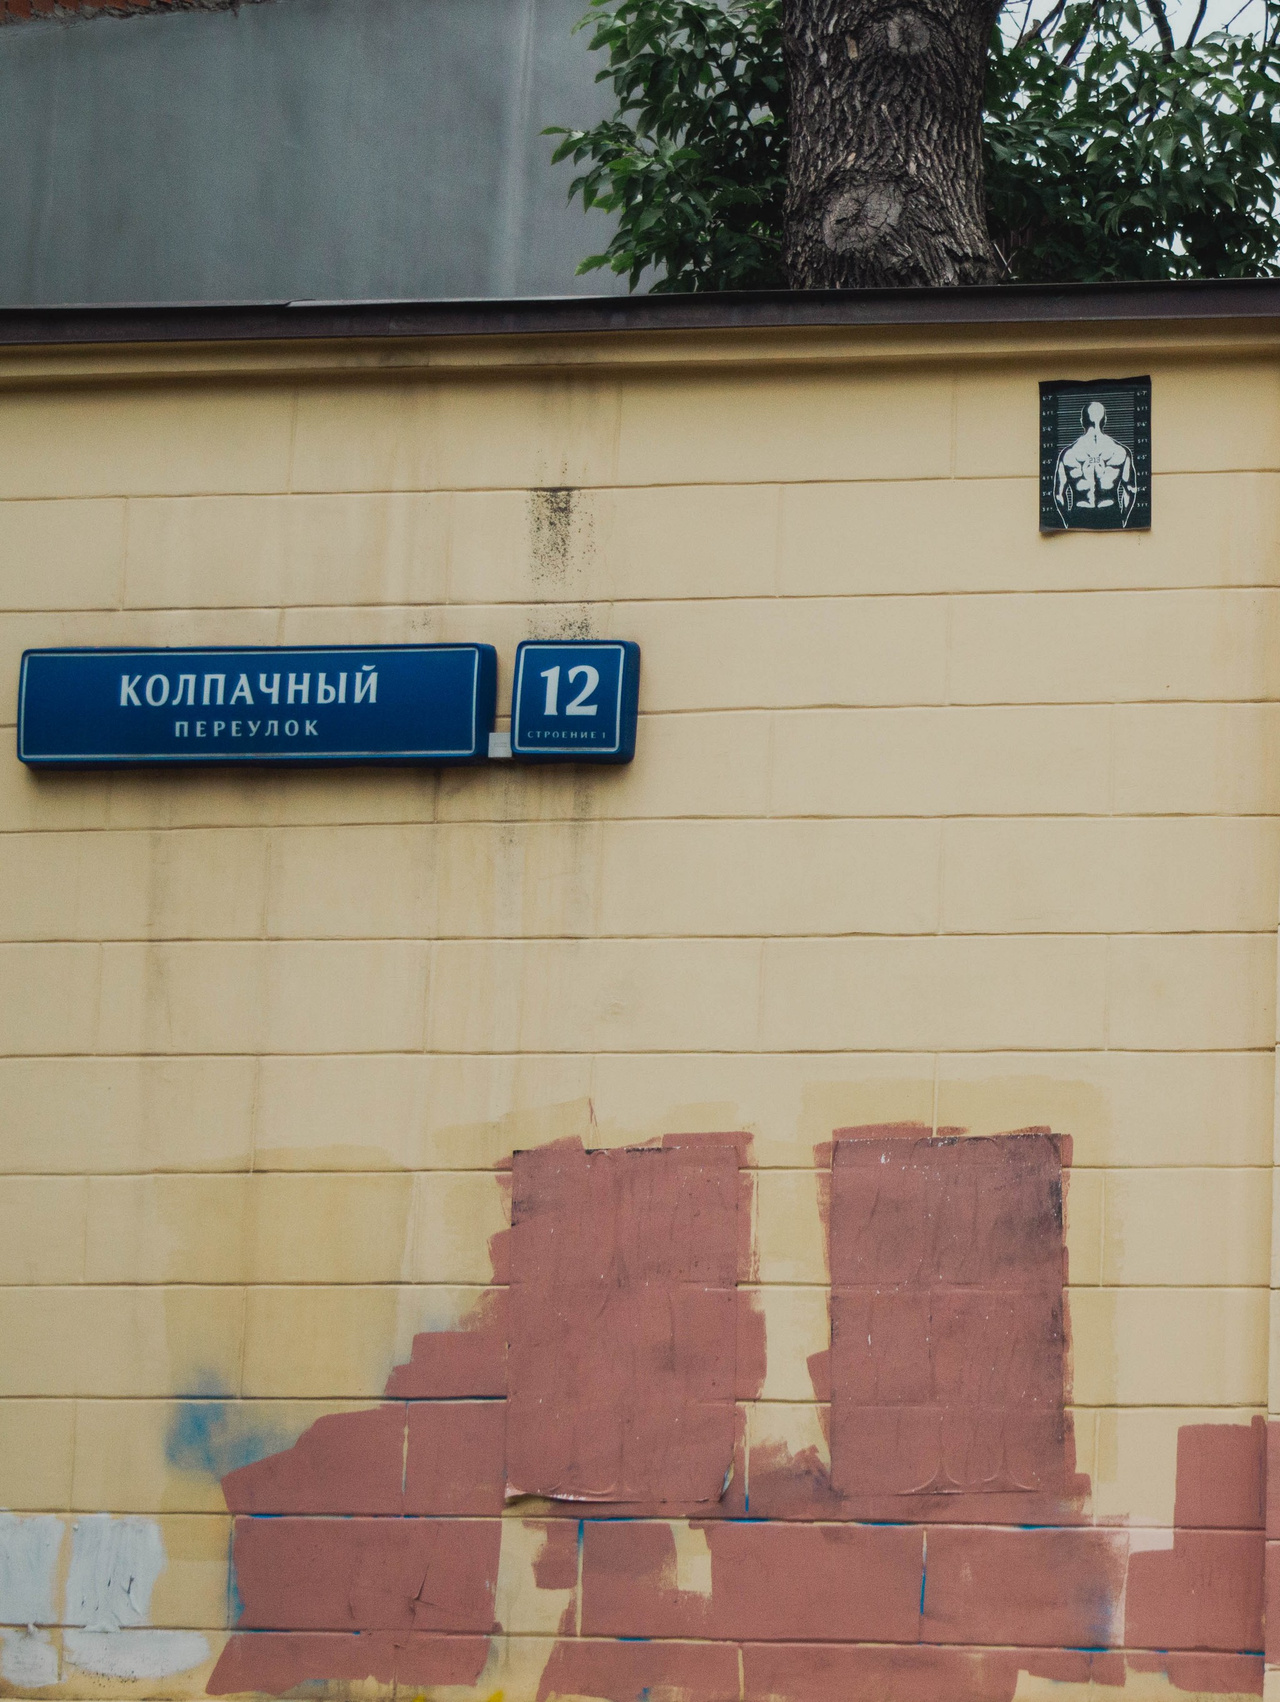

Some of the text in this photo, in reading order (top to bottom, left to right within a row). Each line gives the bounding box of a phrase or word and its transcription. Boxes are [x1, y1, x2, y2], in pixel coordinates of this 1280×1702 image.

[119, 665, 379, 707] КОЛПАЧНЫЙ
[540, 664, 600, 716] 12
[174, 719, 319, 738] ПЕРЕУЛОК
[527, 730, 597, 739] СТРОЕНИЕ
